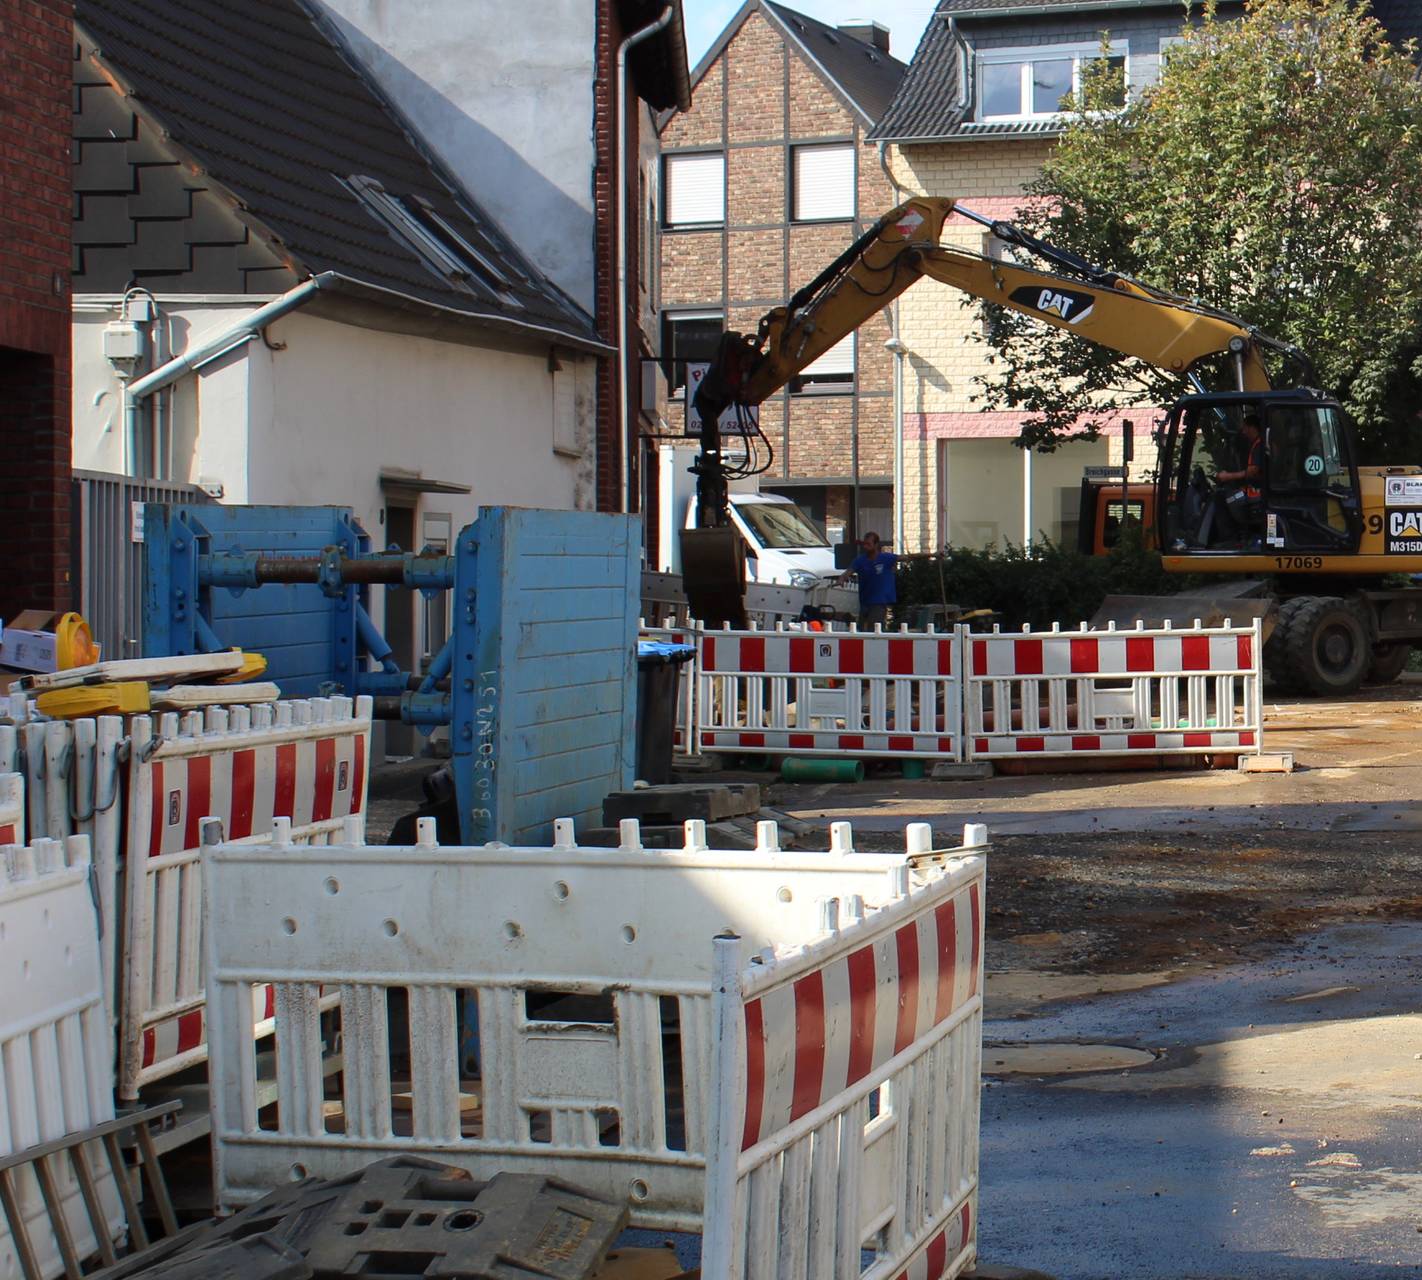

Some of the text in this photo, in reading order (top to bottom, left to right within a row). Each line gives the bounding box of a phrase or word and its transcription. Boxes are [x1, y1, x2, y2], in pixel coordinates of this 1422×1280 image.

[1037, 289, 1073, 319] CAT
[1308, 459, 1320, 471] 20
[1390, 541, 1422, 552] M315D
[1275, 557, 1323, 569] 17069
